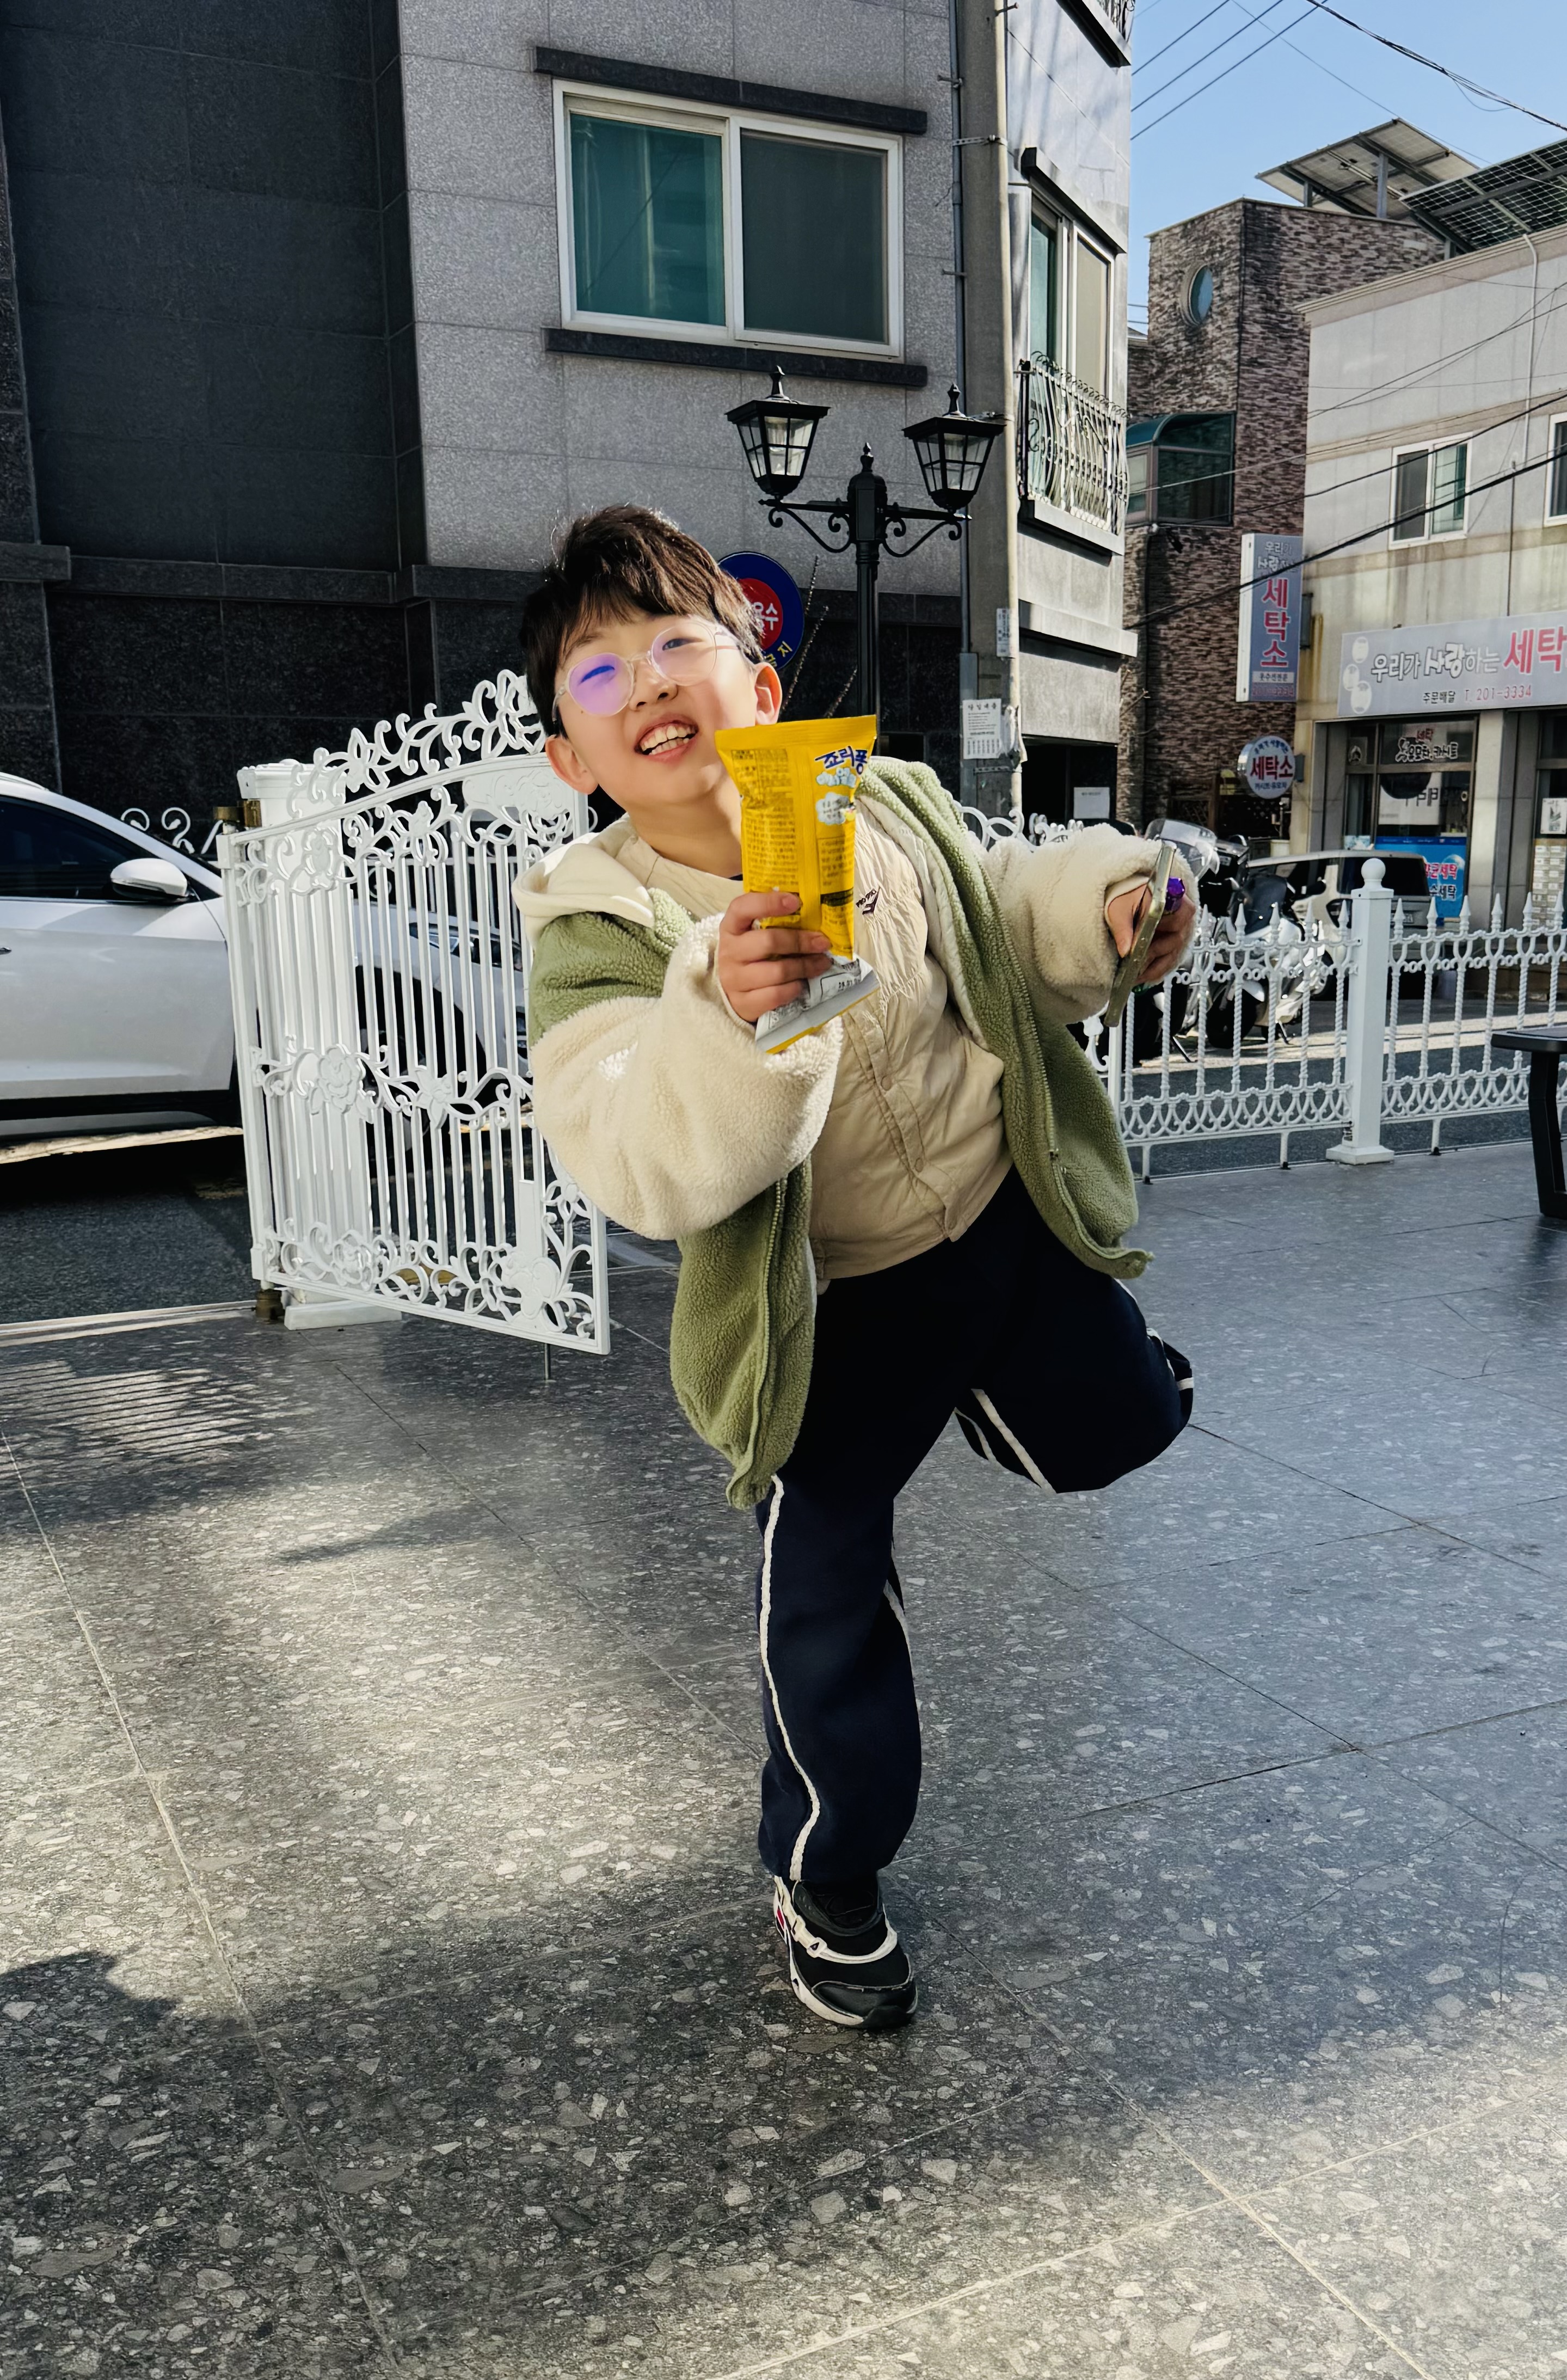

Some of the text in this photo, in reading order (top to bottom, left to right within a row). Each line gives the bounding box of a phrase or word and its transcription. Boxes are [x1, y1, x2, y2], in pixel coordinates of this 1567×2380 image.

[1261, 578, 1291, 668] 세탁소
[1371, 625, 1567, 683] 우리가 사랑하는 세탁
[1423, 691, 1456, 704] 주문배달
[1477, 685, 1532, 701] 201-3334
[815, 745, 868, 775] 죠리퐁
[1250, 755, 1293, 780] 세탁소
